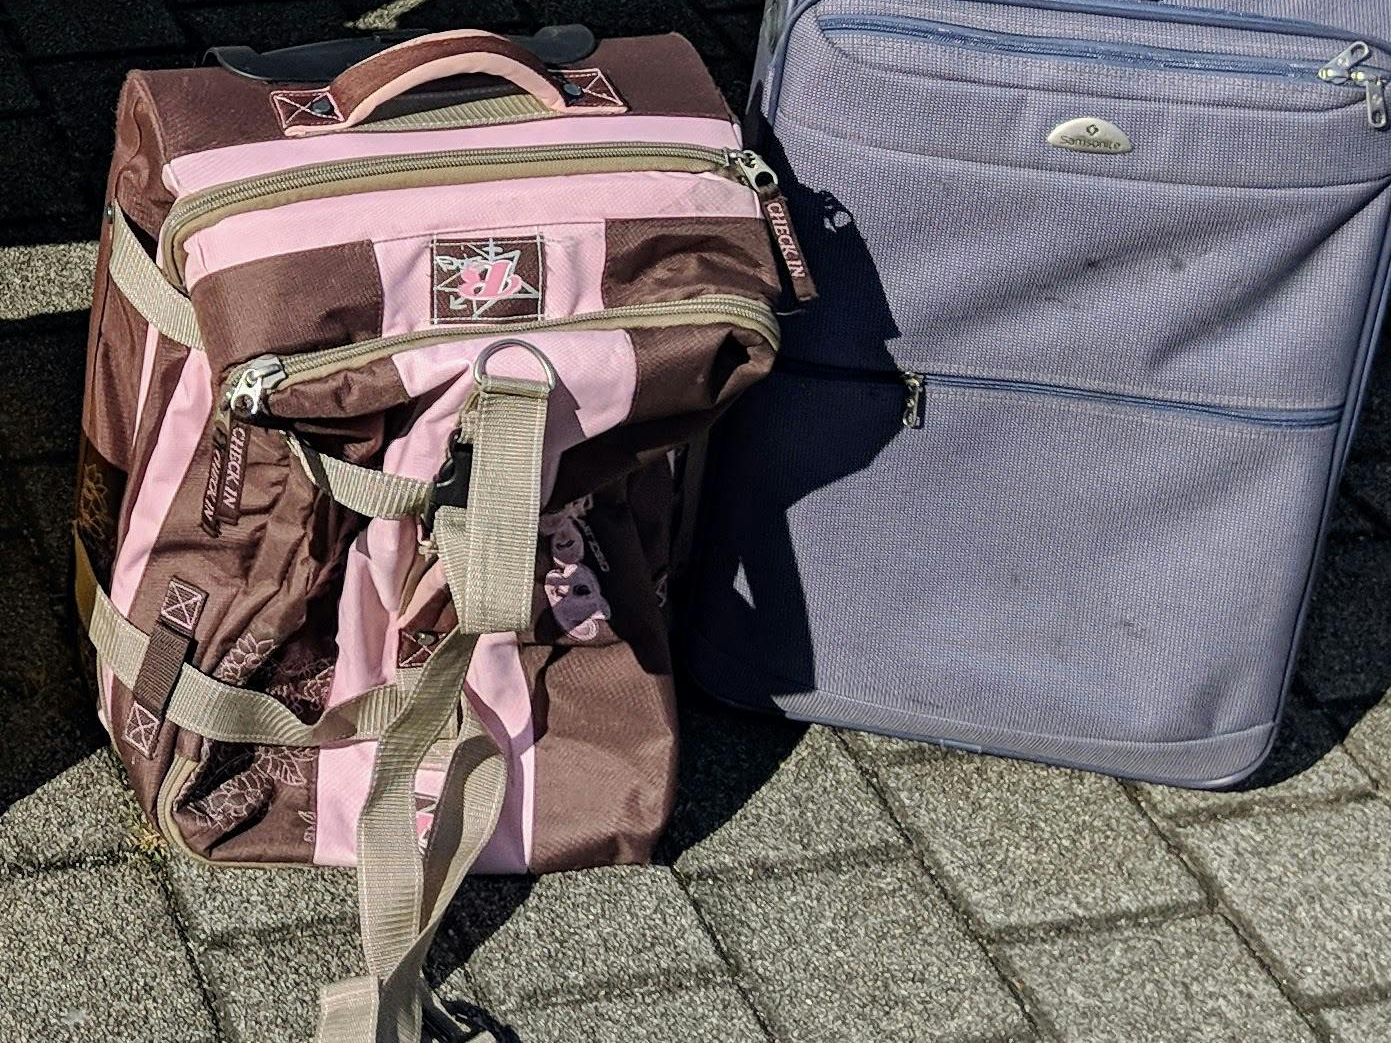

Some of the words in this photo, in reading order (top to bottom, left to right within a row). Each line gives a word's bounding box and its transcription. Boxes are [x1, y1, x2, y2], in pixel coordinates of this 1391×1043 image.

[1060, 135, 1121, 150] Samsonite
[766, 201, 797, 252] CHECK
[784, 252, 807, 281] IN
[227, 426, 246, 485] CHECK
[222, 485, 238, 509] IN
